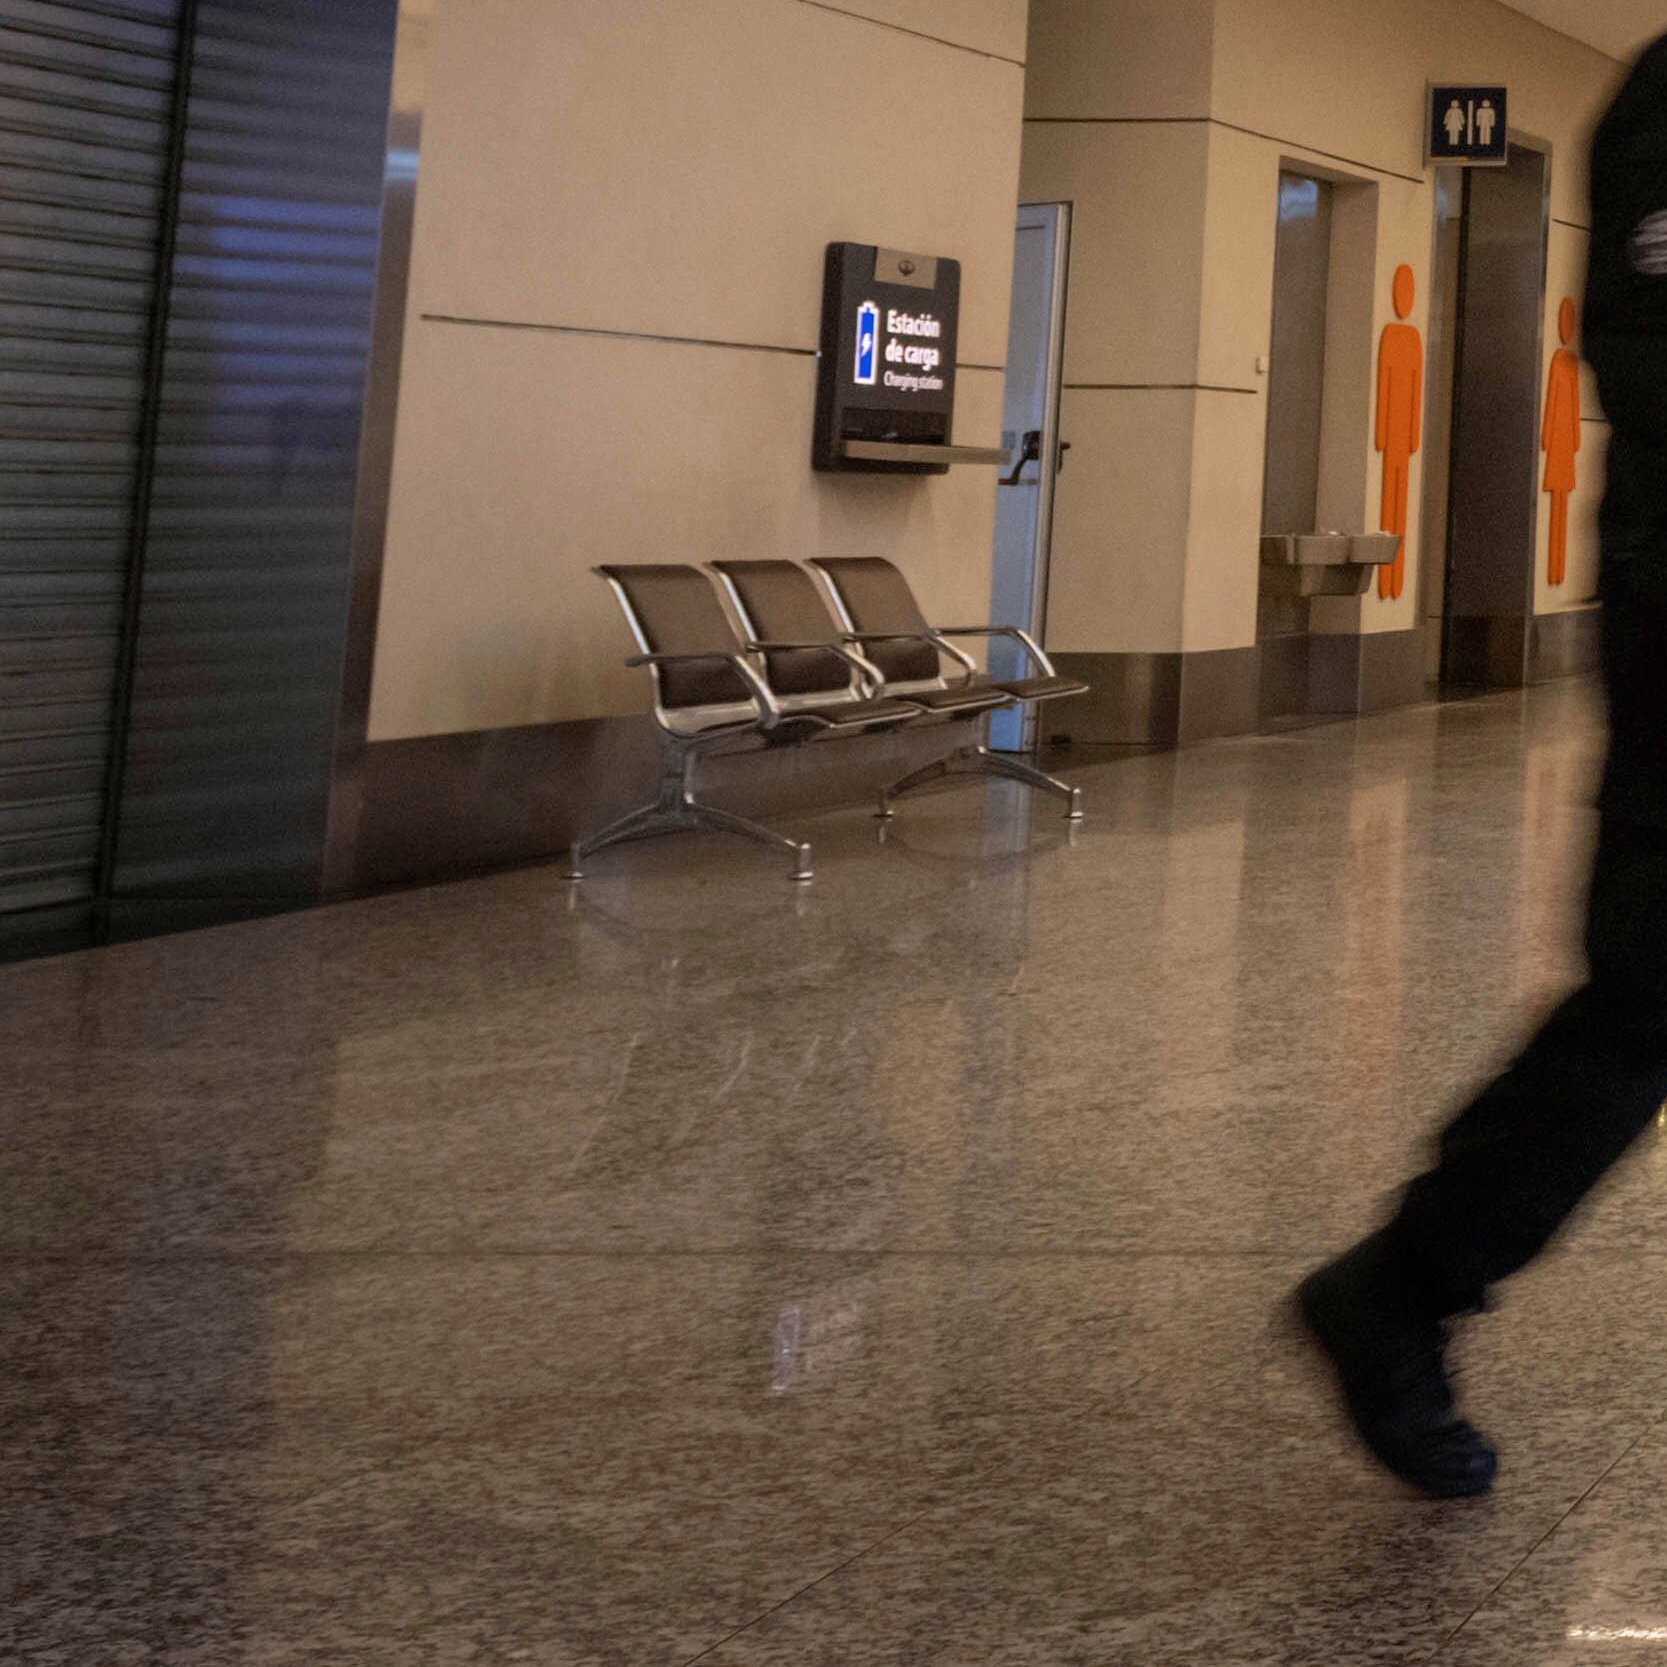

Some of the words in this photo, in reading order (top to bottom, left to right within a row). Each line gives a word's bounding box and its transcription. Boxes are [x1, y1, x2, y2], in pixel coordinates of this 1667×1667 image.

[887, 308, 940, 338] Estación
[885, 338, 904, 363] de
[904, 345, 940, 371] carga
